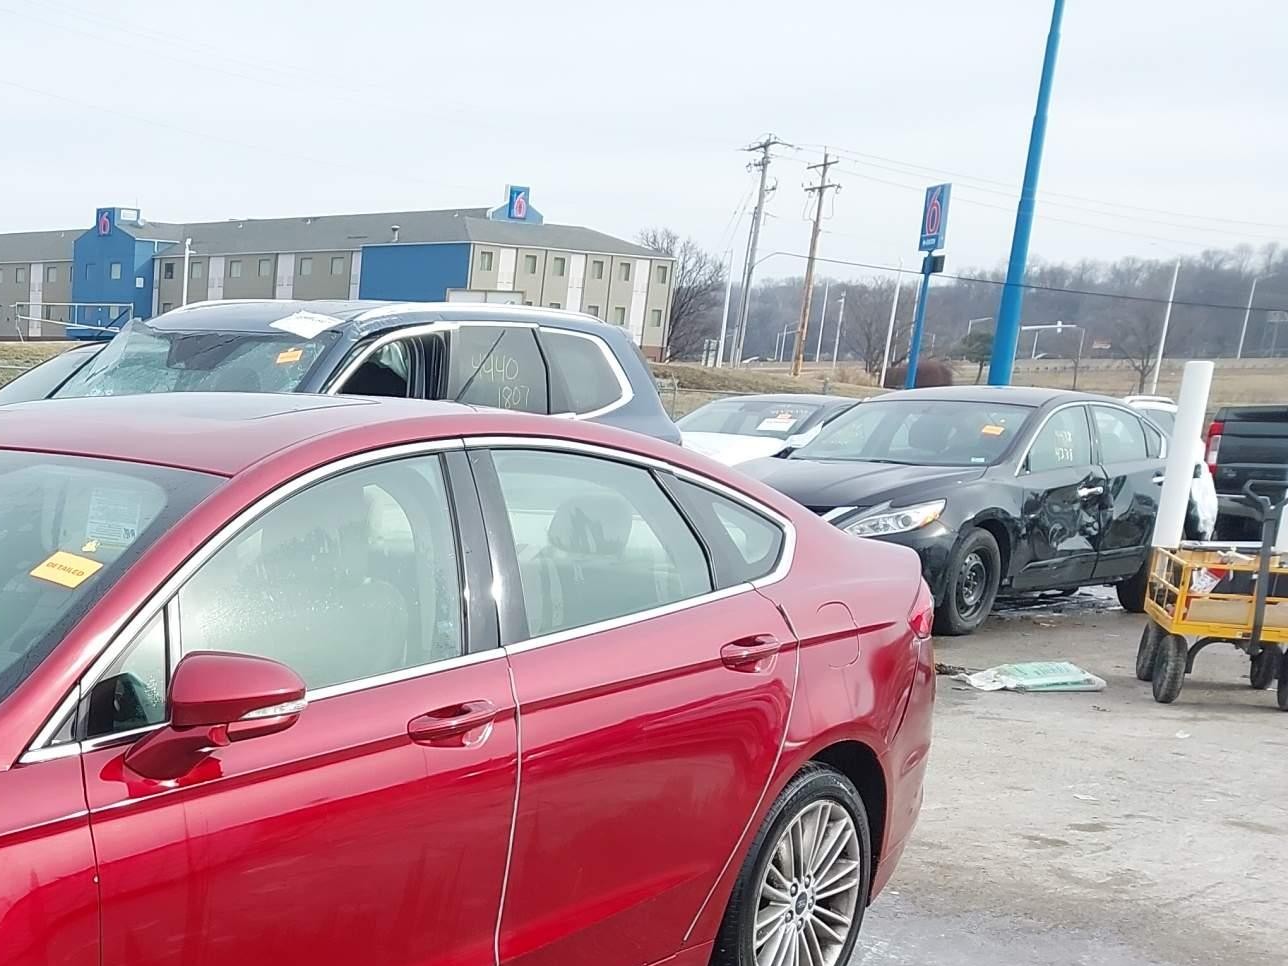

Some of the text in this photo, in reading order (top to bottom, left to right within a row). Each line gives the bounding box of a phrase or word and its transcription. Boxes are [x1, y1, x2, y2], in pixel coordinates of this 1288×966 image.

[925, 186, 941, 235] 6
[471, 352, 519, 382] 4440
[498, 386, 530, 409] 1807
